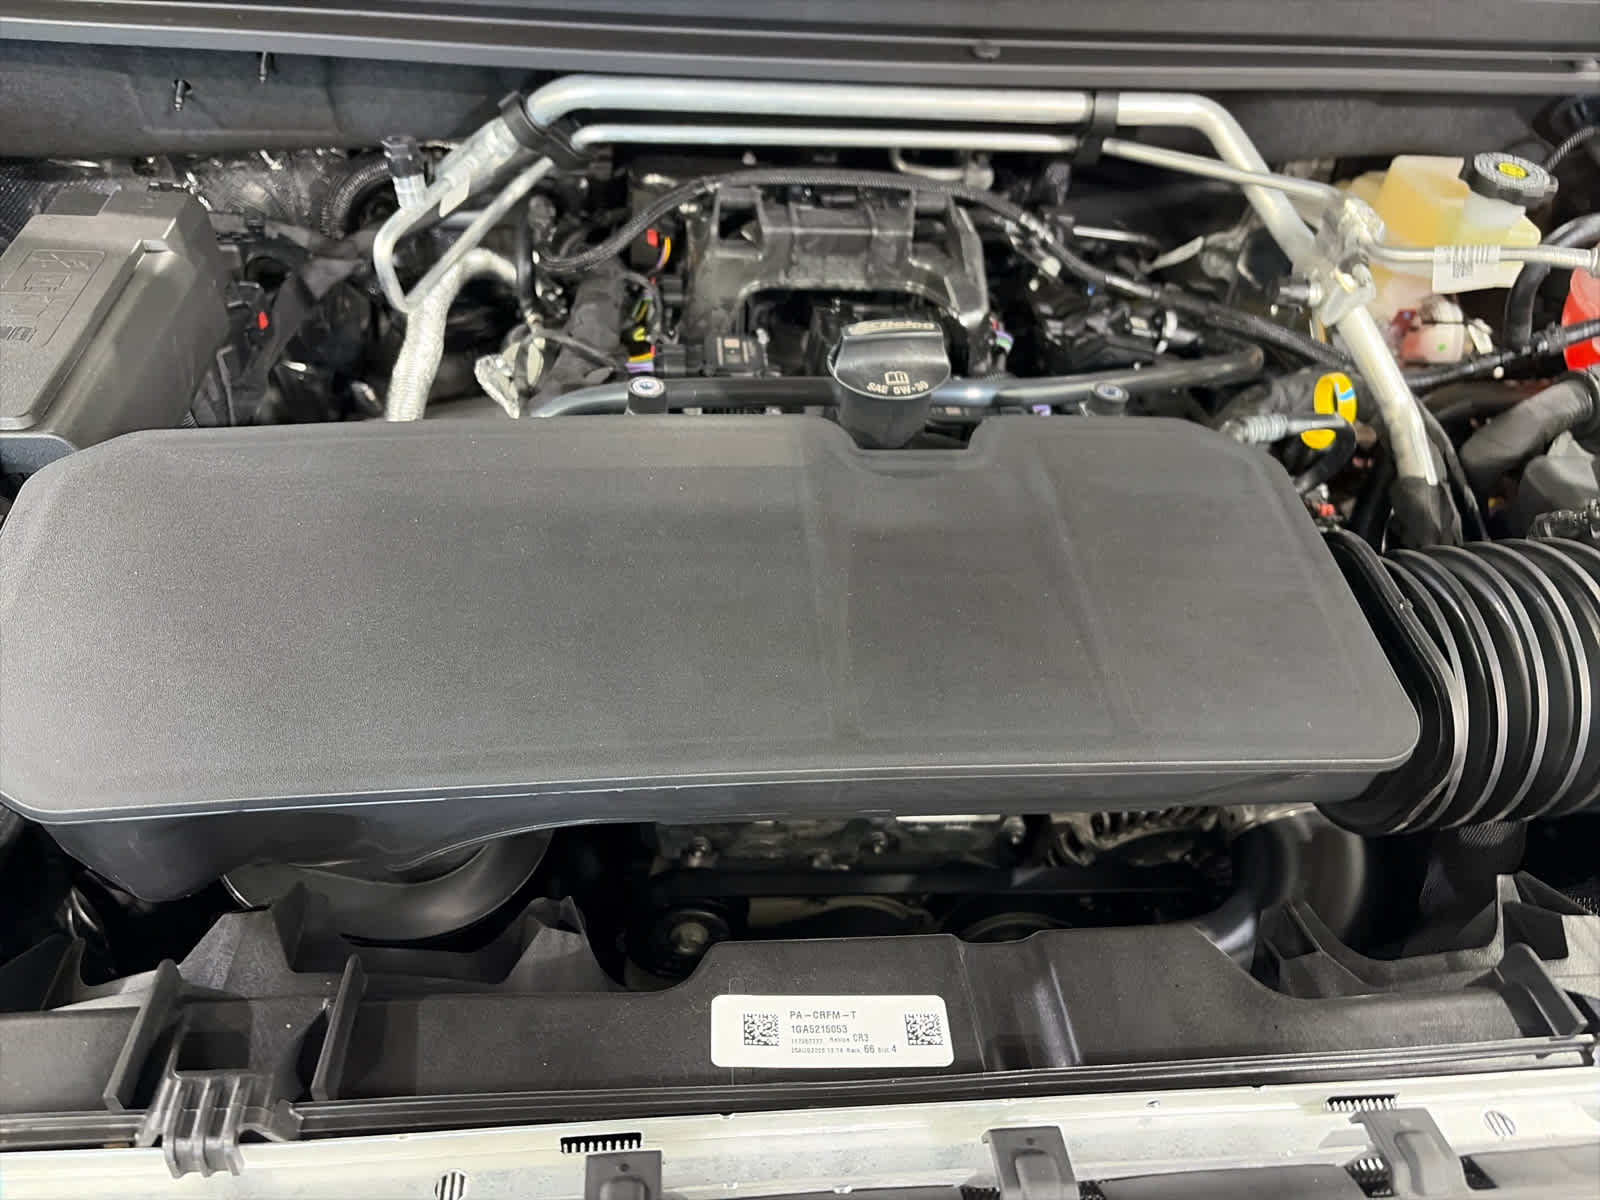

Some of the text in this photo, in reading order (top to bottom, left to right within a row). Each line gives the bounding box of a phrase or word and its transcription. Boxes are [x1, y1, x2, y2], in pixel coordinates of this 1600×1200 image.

[866, 381, 889, 395] SAE
[852, 1033, 869, 1043] CR3
[863, 1044, 875, 1054] 66
[891, 1044, 897, 1053] 4
